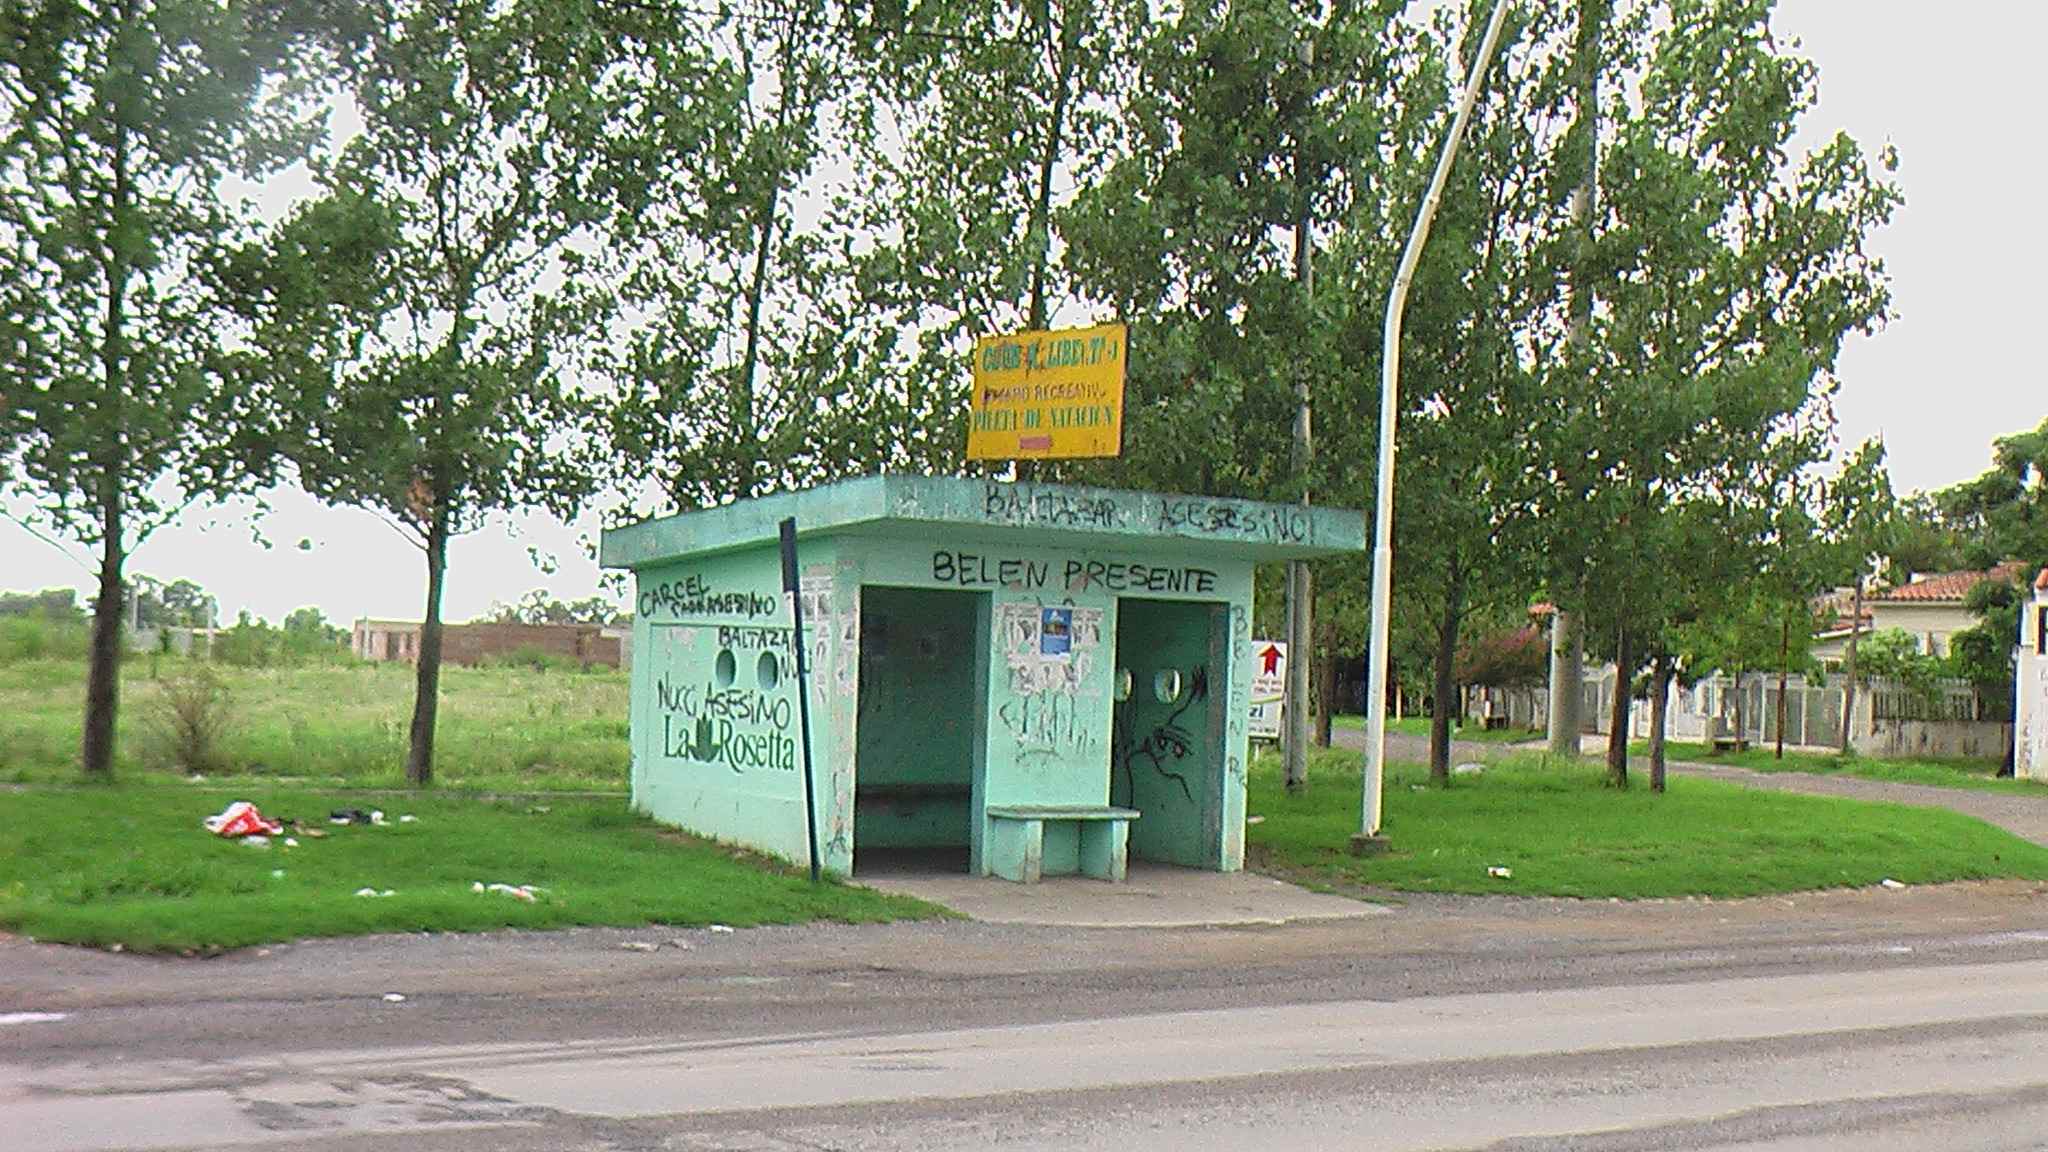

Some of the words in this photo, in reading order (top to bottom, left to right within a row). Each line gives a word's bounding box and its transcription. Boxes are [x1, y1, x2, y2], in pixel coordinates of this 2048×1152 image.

[933, 550, 1048, 588] BELEN
[1064, 558, 1218, 593] PRESENTE
[639, 573, 711, 618] CARCEL
[664, 714, 689, 761] La
[719, 717, 795, 774] Rosetta
